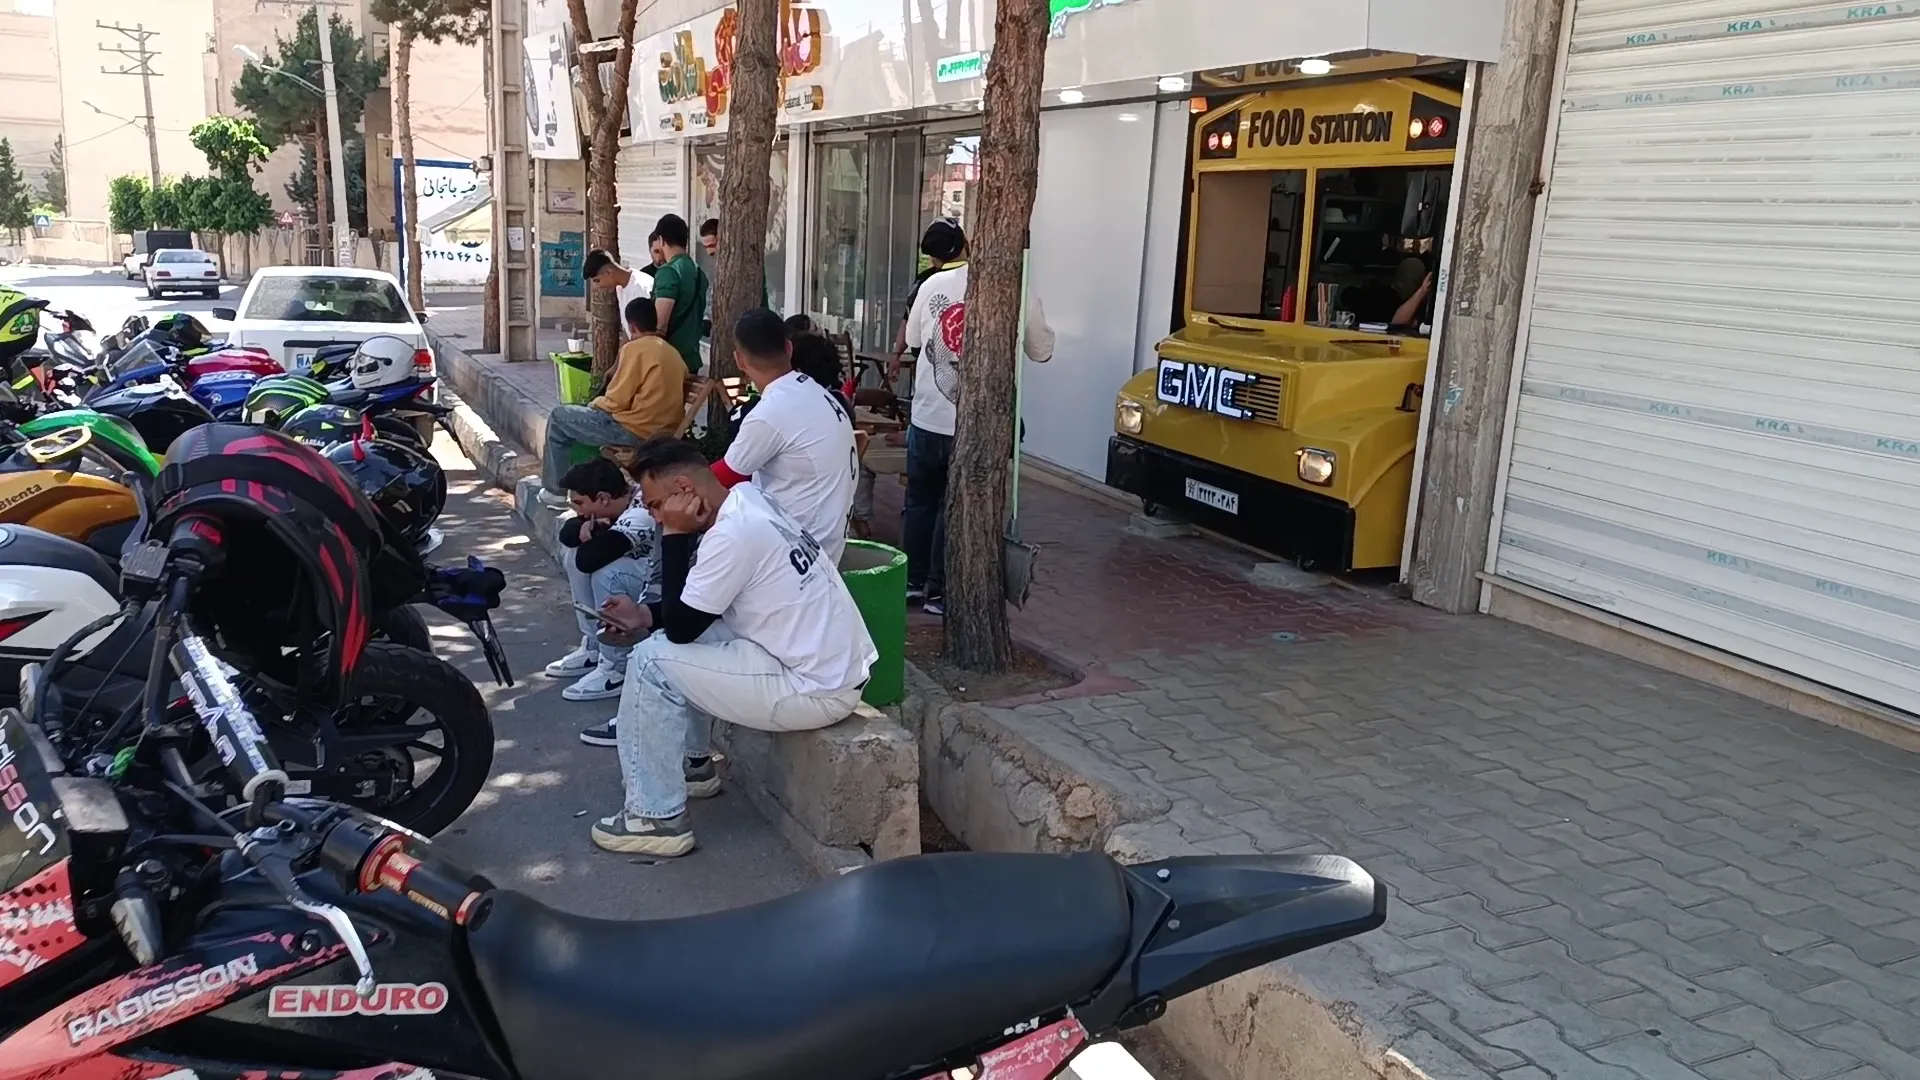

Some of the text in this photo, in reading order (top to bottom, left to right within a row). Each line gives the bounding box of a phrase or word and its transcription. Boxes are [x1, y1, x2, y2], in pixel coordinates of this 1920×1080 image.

[1727, 20, 1762, 33] KRA
[1625, 33, 1657, 46] KRA
[1722, 85, 1755, 97] KRA
[1247, 108, 1394, 148] FOOD STATION
[1157, 358, 1248, 419] GMC
[1755, 417, 1791, 433] KRA
[67, 952, 260, 1047] RADISSON
[270, 984, 448, 1016] ENDURO
